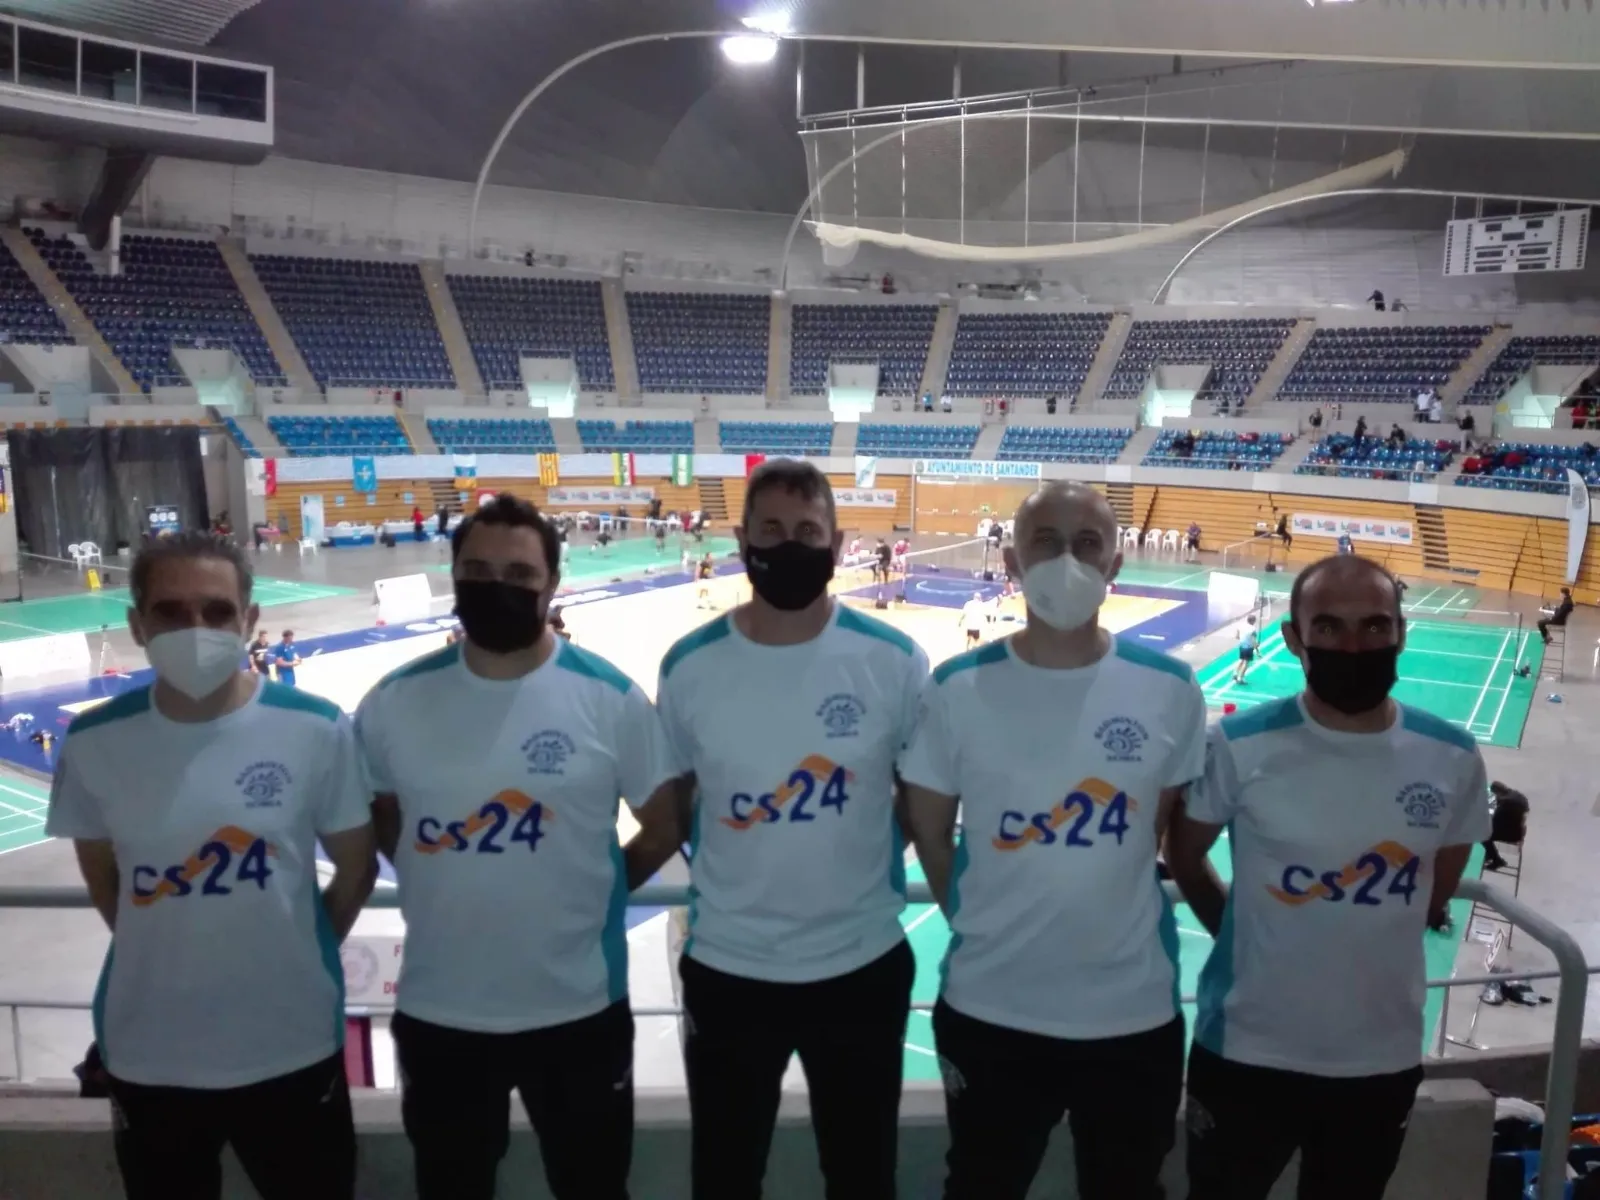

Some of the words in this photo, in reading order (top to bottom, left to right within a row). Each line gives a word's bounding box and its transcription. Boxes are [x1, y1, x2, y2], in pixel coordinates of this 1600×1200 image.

[927, 462, 982, 475] AYUNTAMIENTO
[984, 463, 995, 476] DE
[996, 463, 1038, 476] SANTANDER
